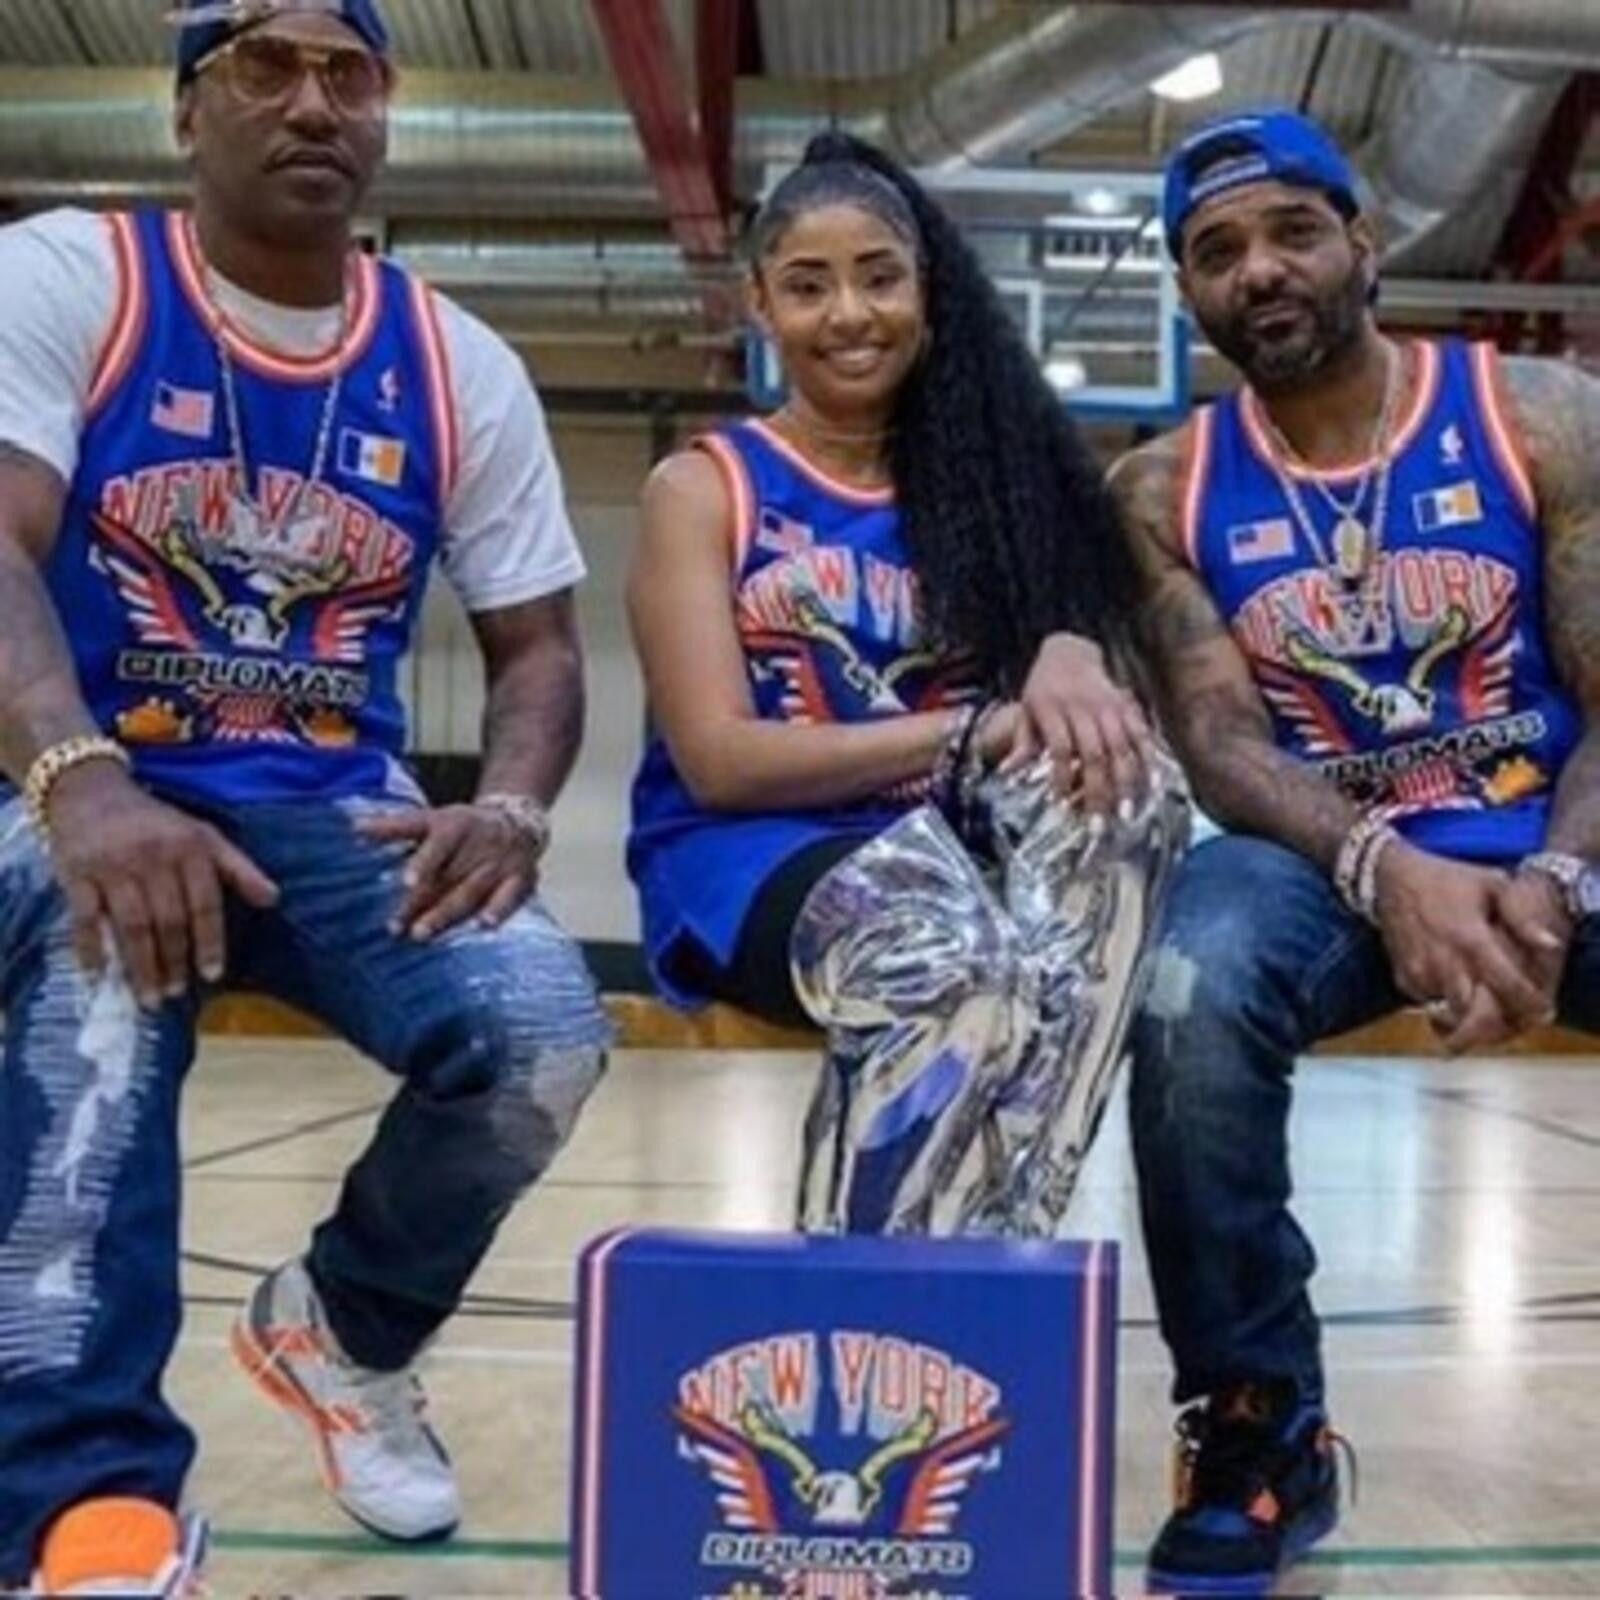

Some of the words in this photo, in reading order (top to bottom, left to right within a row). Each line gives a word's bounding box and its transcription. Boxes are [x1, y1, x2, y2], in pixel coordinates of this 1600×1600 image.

[678, 1331, 817, 1438] NEW
[829, 1331, 1001, 1446] YORK
[701, 1533, 974, 1575] DIPLOMATS
